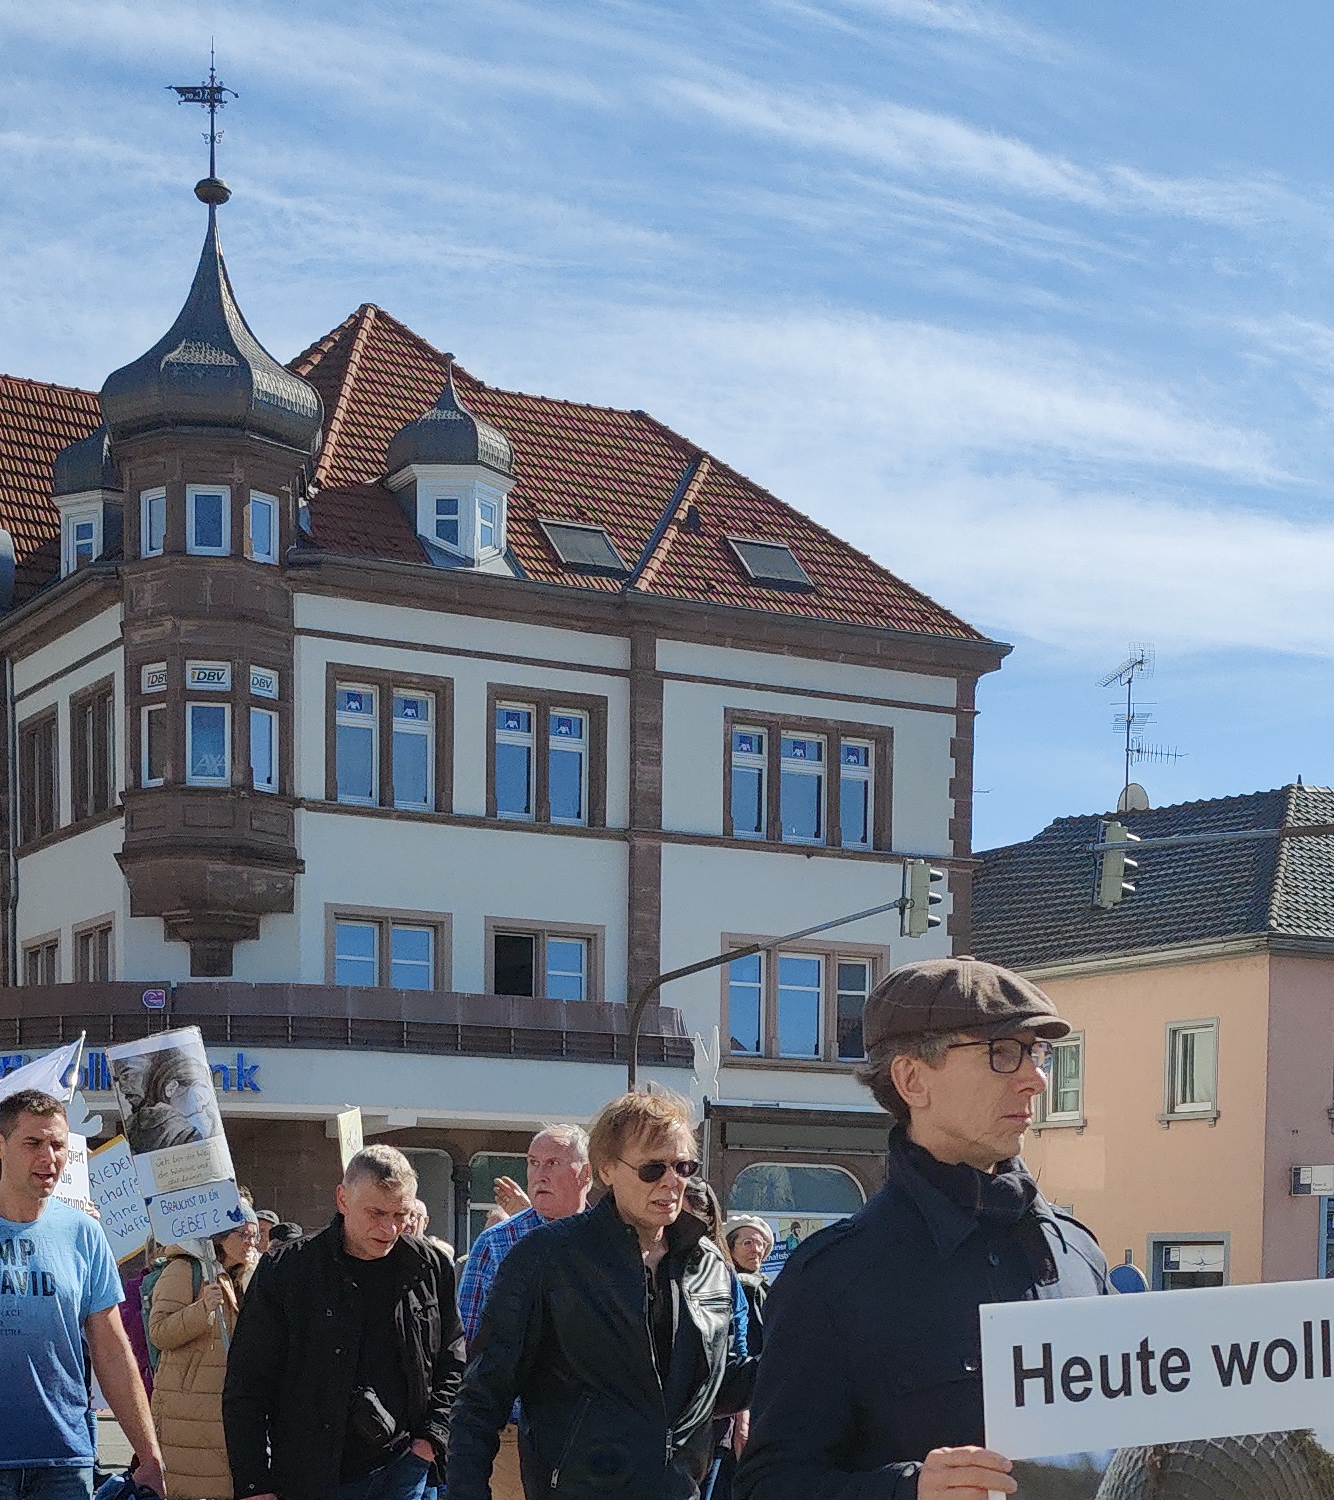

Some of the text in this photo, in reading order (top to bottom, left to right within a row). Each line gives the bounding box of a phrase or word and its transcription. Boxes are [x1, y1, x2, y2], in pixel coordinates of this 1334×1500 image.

[196, 671, 226, 681] DBV
[251, 676, 273, 689] DBV
[37, 1052, 261, 1091] olknk
[105, 1203, 139, 1226] ohne
[171, 1211, 207, 1238] GEBET
[1011, 1336, 1192, 1407] Heute
